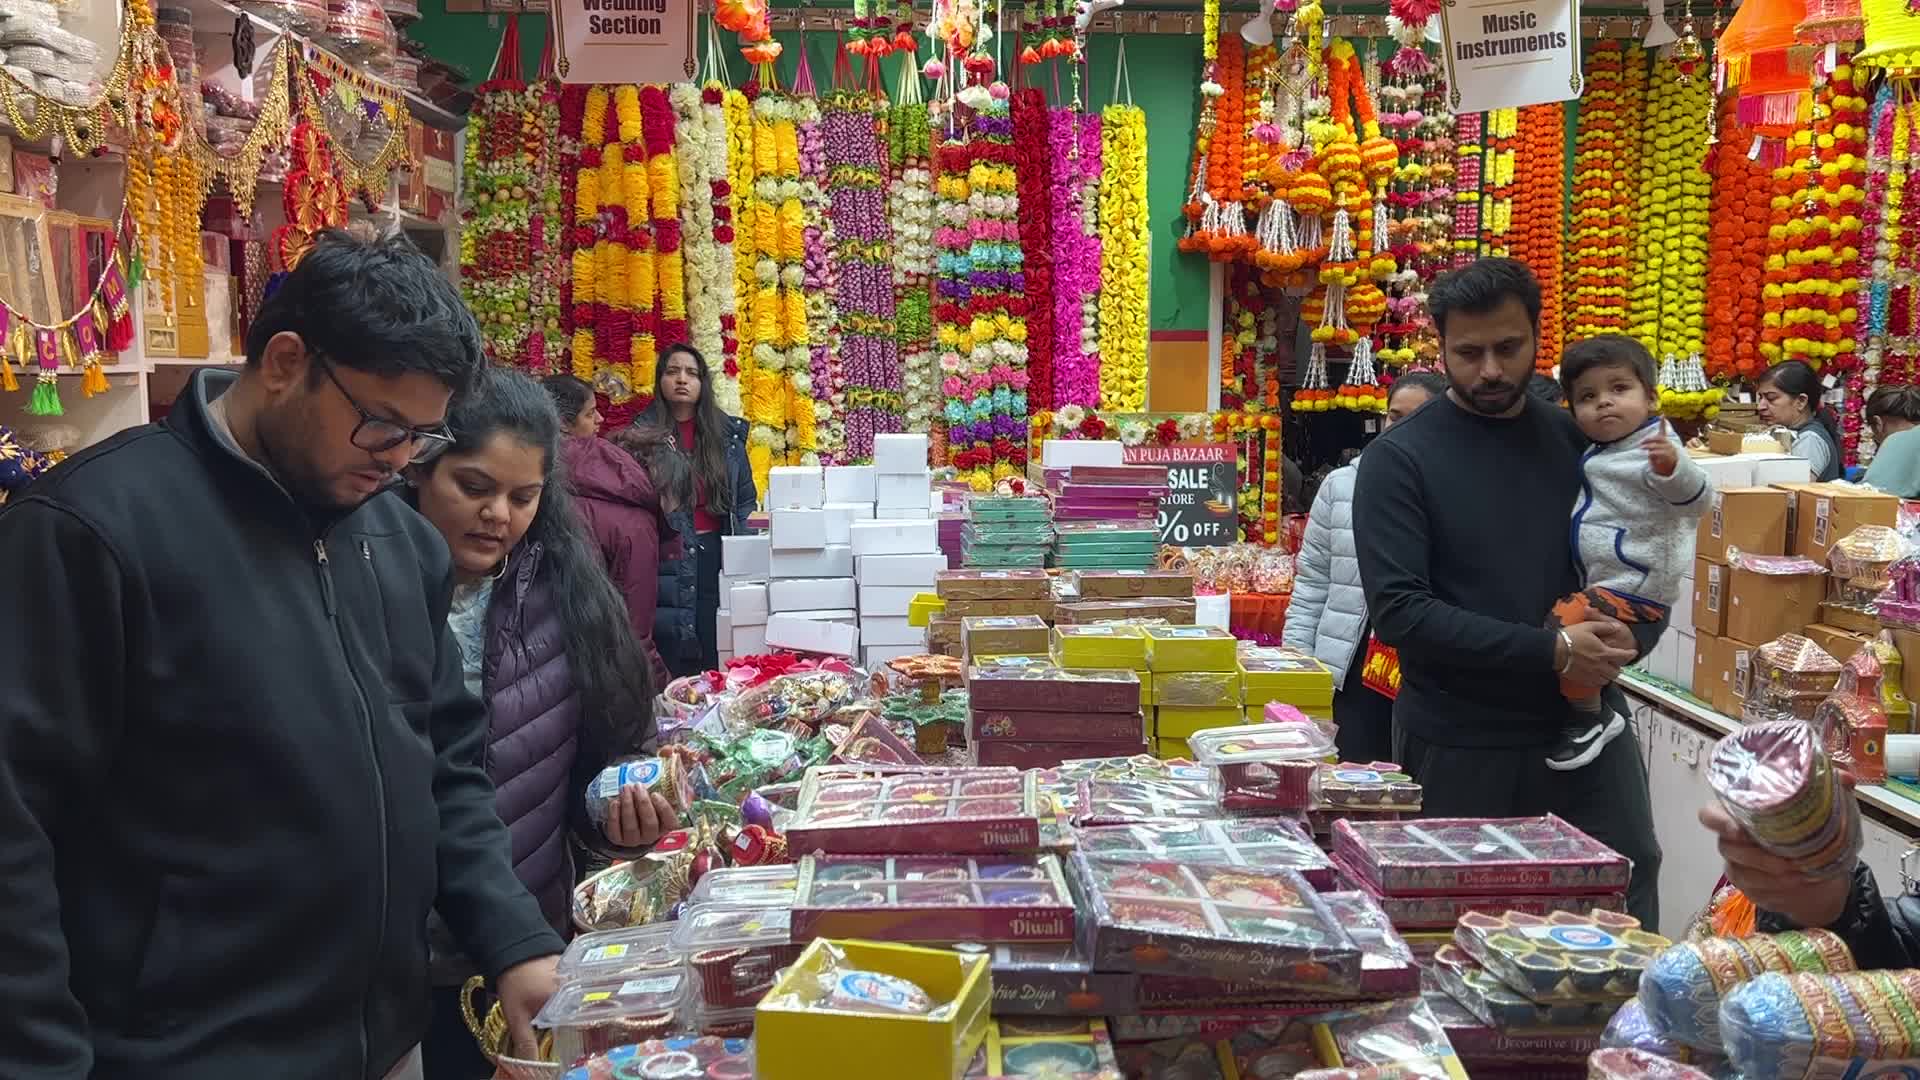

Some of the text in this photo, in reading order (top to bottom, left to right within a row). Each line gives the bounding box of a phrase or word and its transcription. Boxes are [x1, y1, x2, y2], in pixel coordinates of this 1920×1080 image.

[589, 15, 661, 35] Section
[1483, 11, 1537, 34] Music
[1456, 31, 1567, 60] instruments
[1140, 447, 1170, 461] PUJA
[1173, 447, 1224, 461] BAZAAR
[1168, 468, 1208, 489] SALE
[1160, 493, 1196, 505] STORE
[1193, 522, 1220, 537] OFF
[979, 828, 1030, 847] Diwali
[1009, 918, 1064, 936] Diwali
[1020, 983, 1056, 1010] Diya
